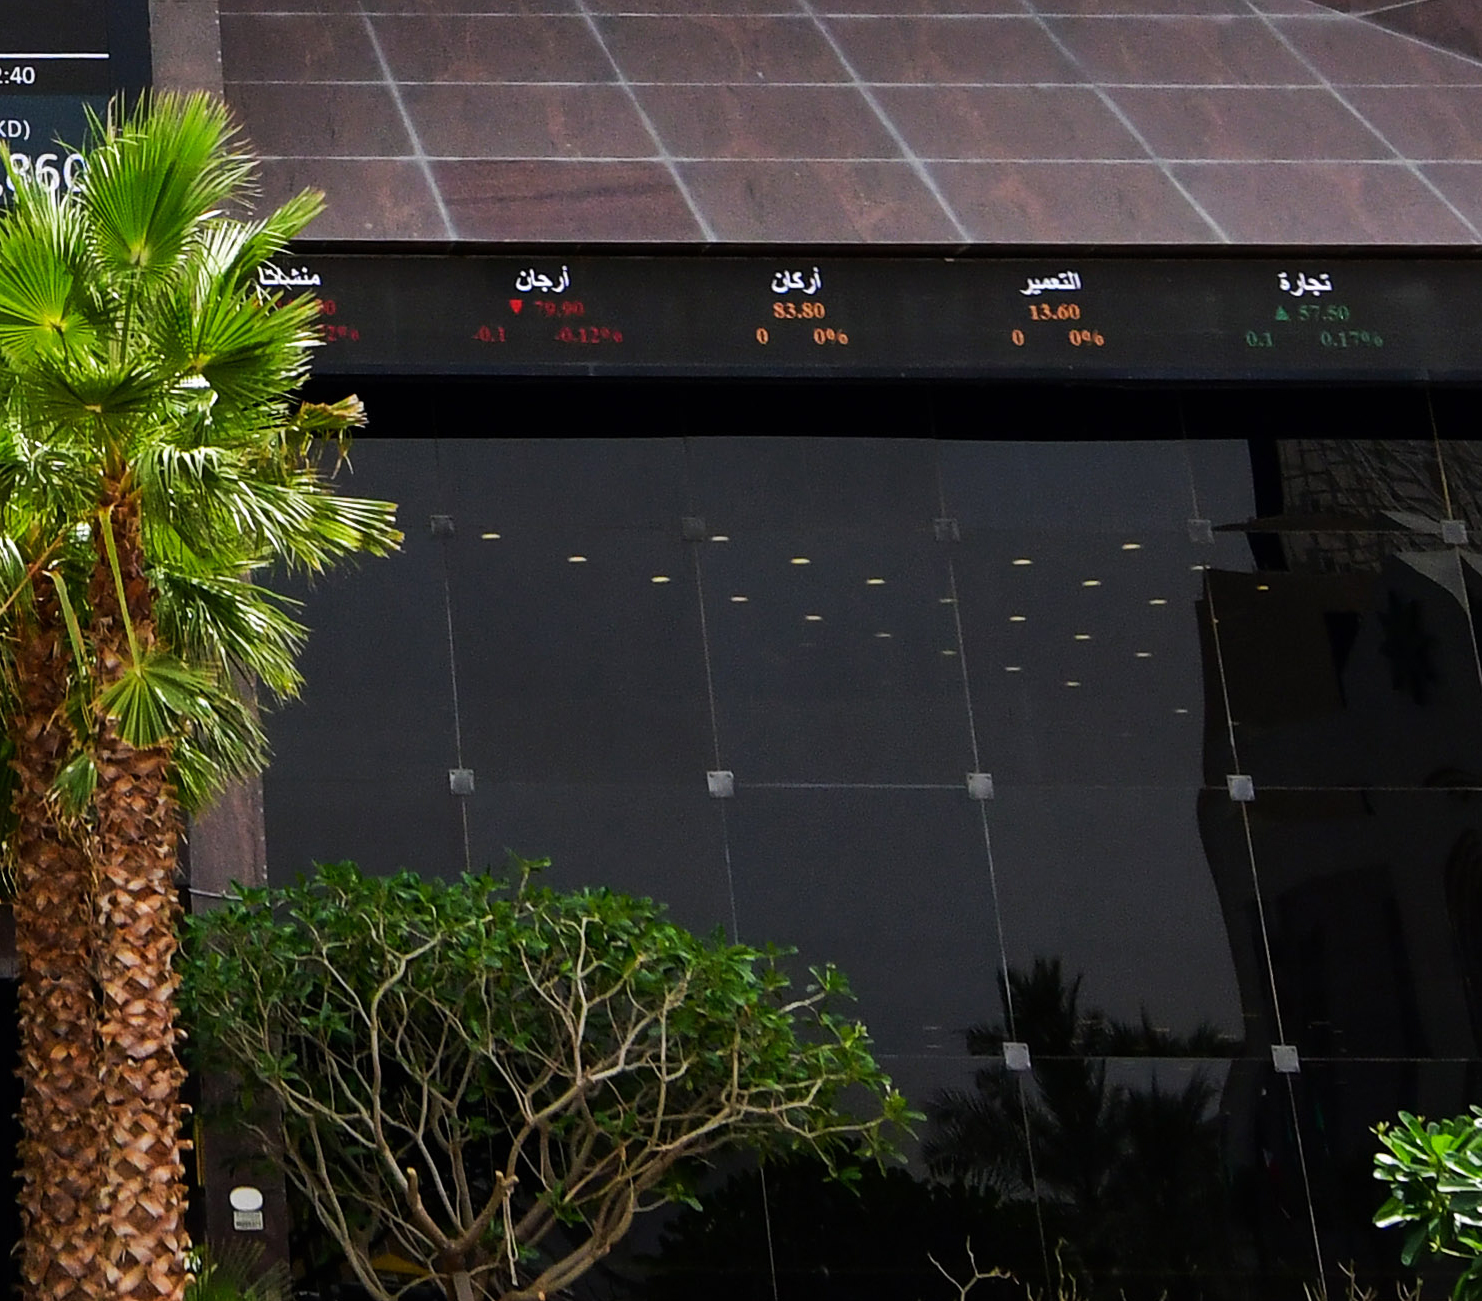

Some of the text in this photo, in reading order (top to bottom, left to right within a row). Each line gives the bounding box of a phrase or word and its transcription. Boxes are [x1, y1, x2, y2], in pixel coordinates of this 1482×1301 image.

[1277, 272, 1333, 297] تجارة
[773, 302, 825, 319] 83.80
[1029, 303, 1080, 320] 13.60
[756, 327, 849, 345] 0 0%
[1011, 329, 1105, 346] 0 0%
